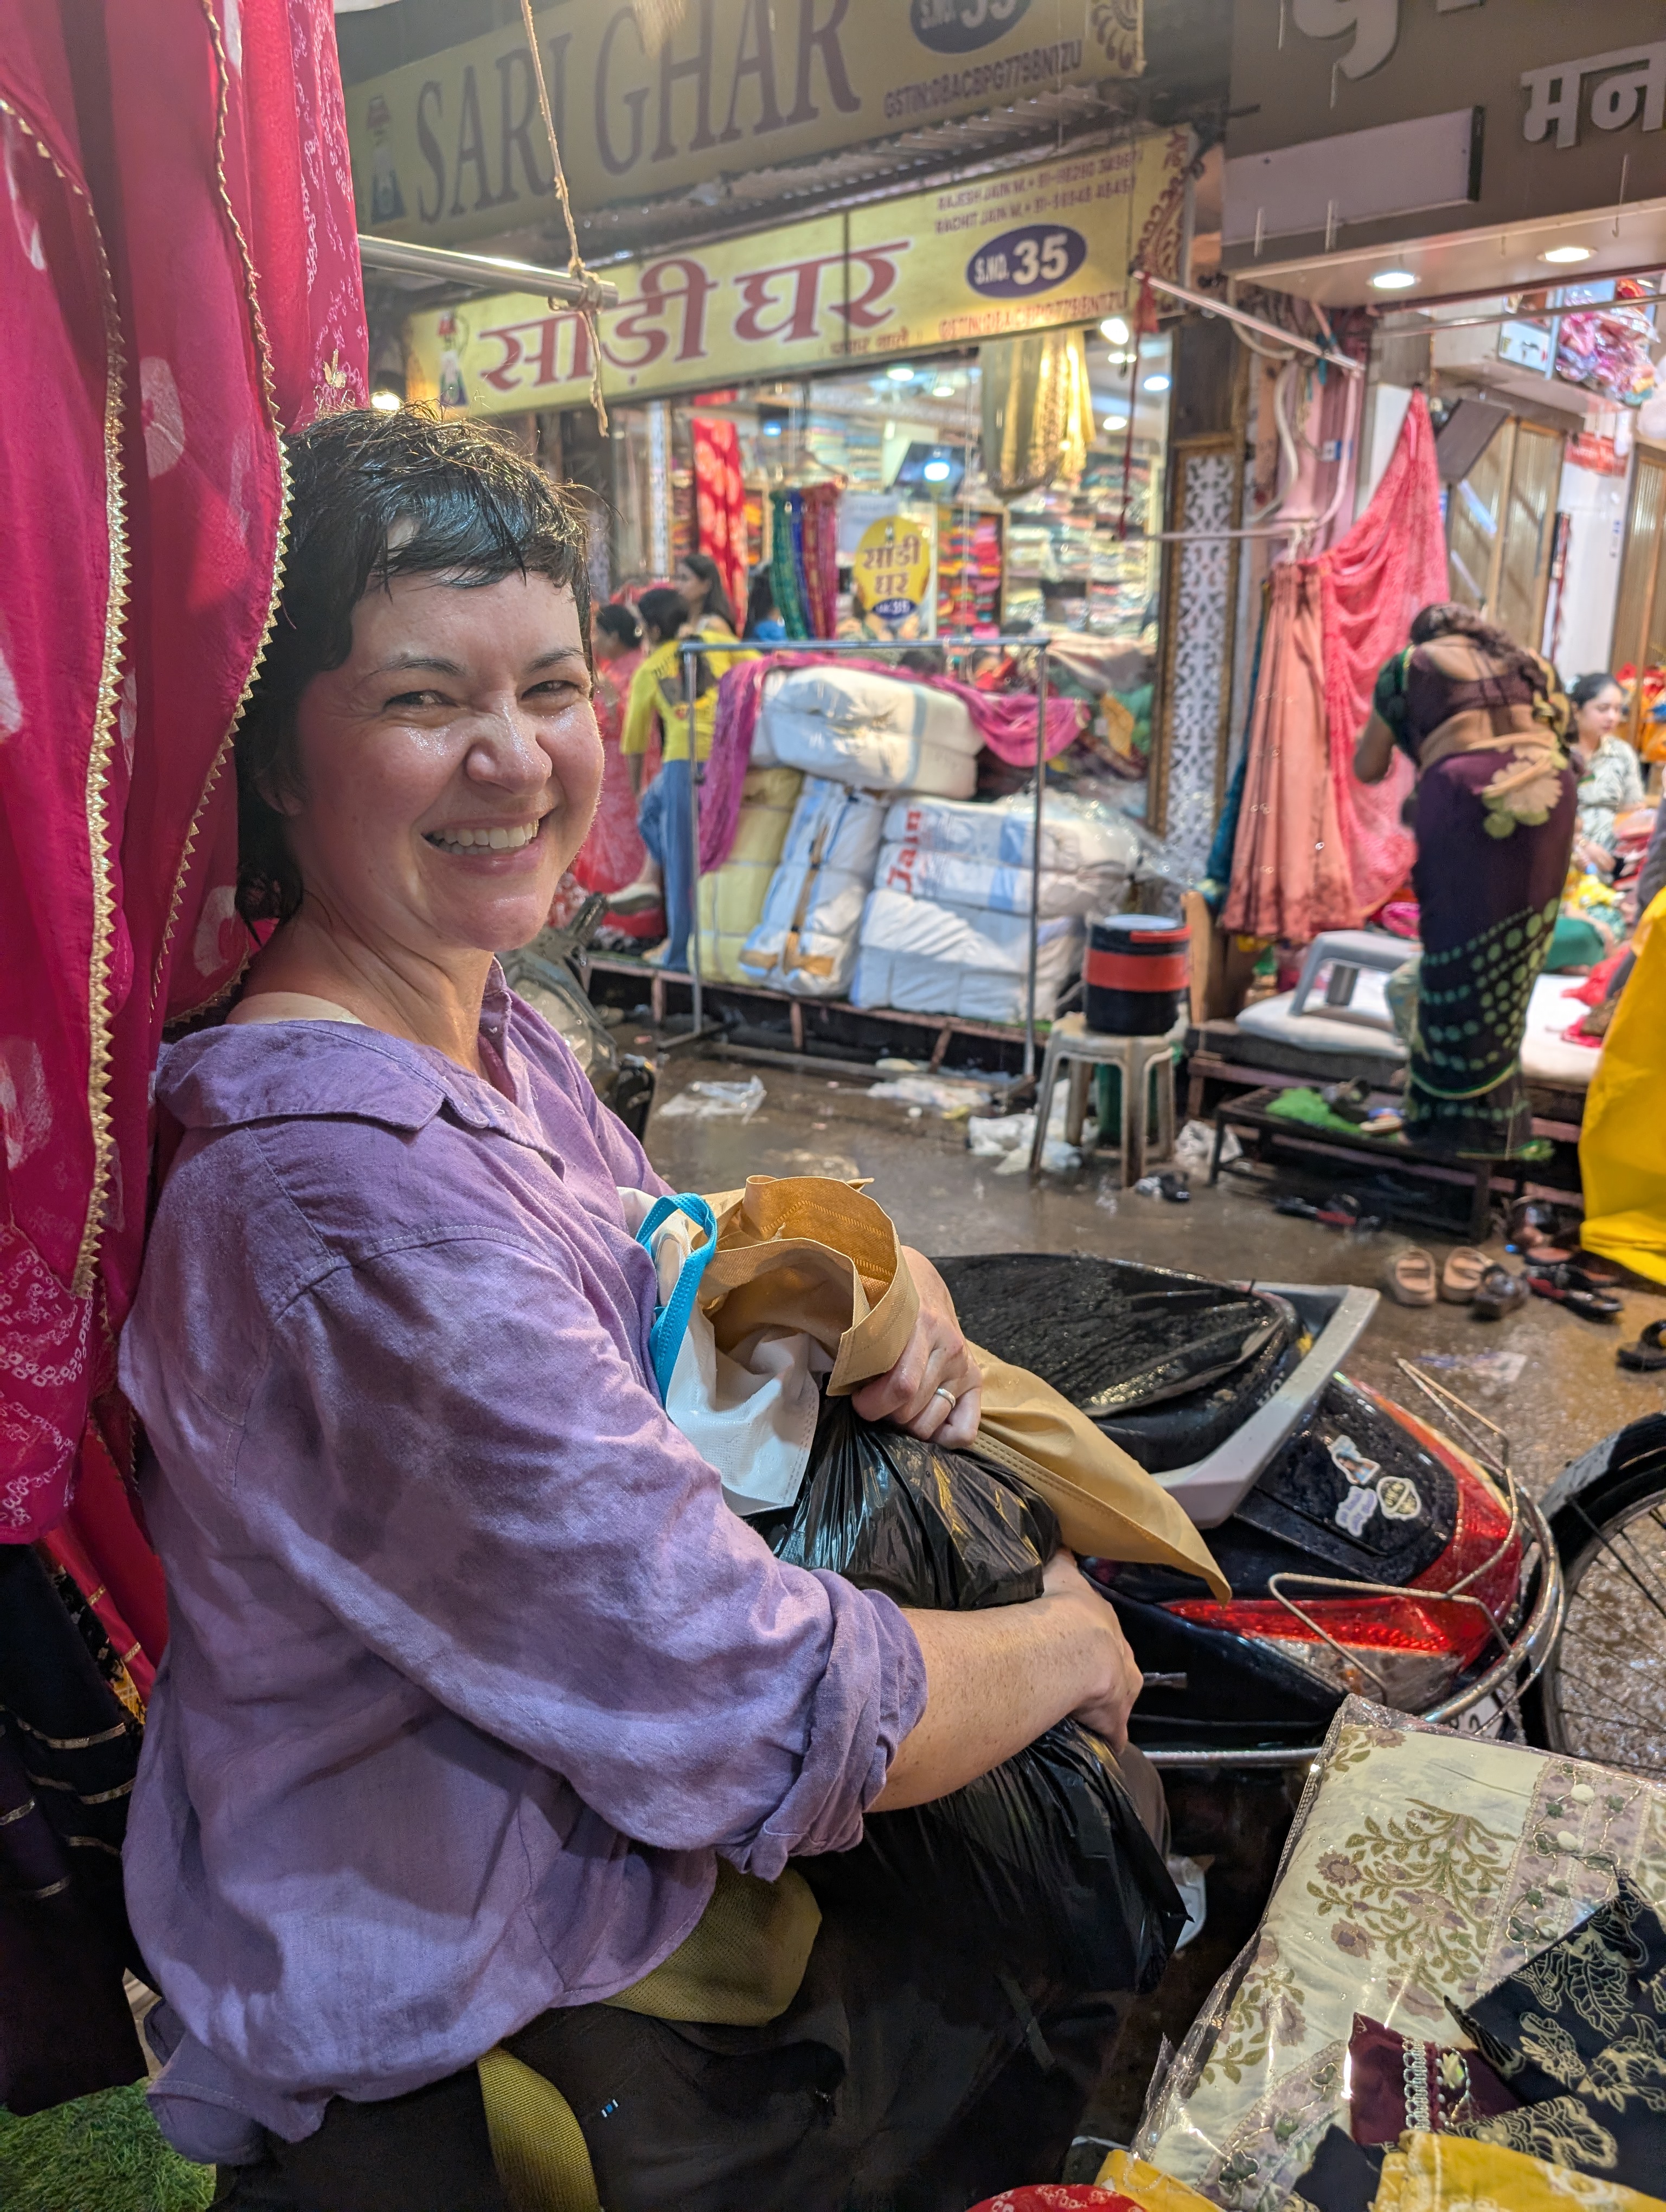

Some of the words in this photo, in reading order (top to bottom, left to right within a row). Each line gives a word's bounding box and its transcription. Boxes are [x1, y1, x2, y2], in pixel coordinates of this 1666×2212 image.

[416, 33, 571, 224] SARI
[595, 0, 861, 175] GHAR
[478, 258, 718, 391] साड़ी
[733, 240, 911, 344] घर
[1011, 233, 1069, 286] 35
